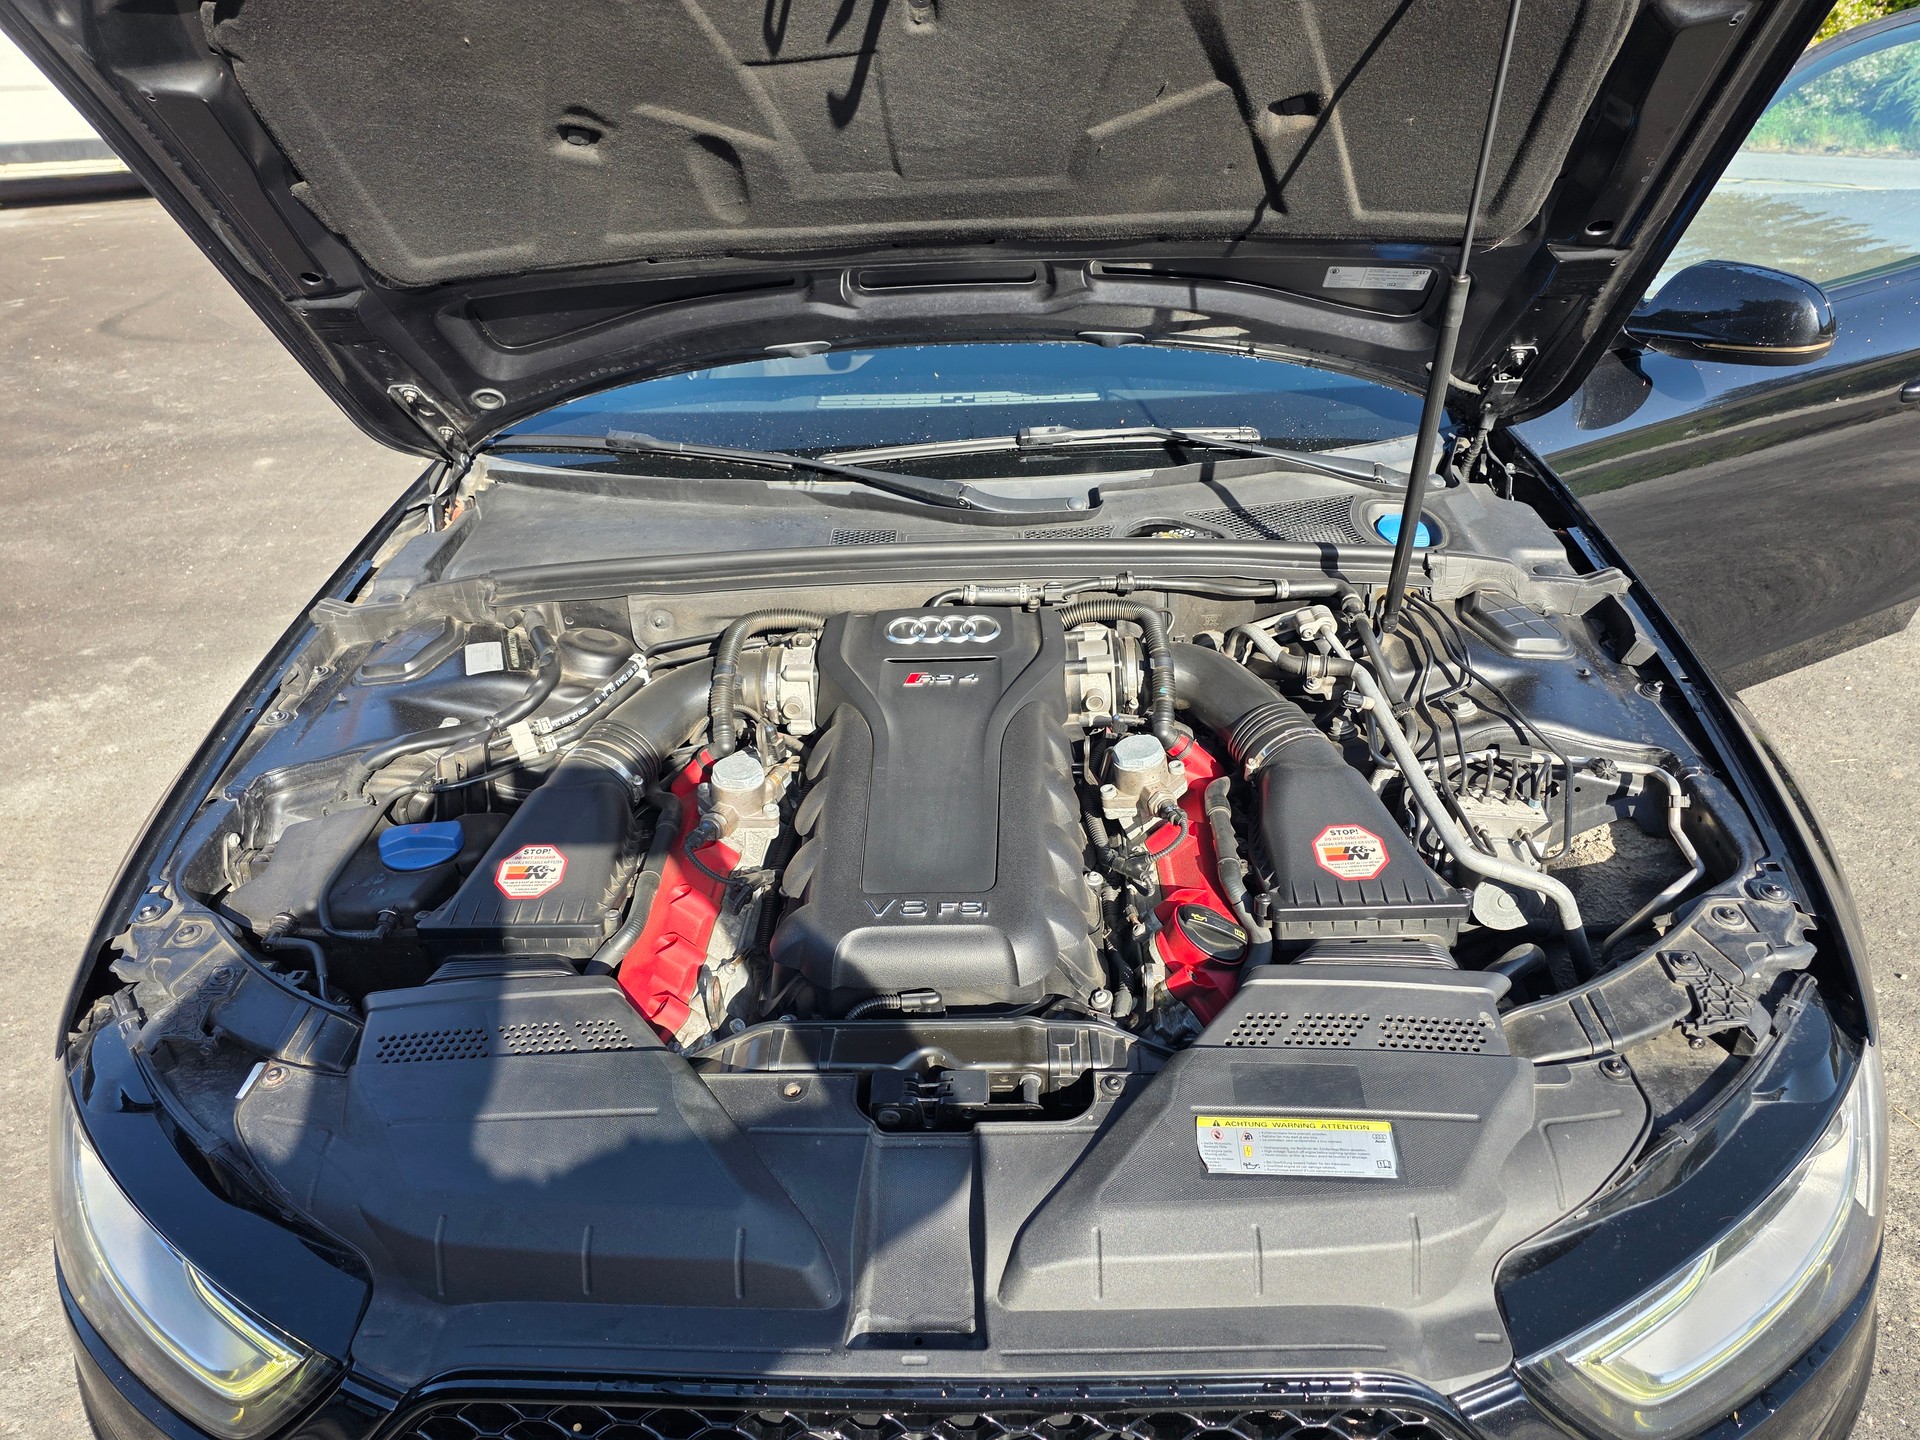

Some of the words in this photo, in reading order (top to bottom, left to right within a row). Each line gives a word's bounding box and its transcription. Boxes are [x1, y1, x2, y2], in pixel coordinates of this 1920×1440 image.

[959, 673, 979, 685] 4
[1330, 828, 1359, 836] STOP!
[1343, 845, 1376, 860] K&N
[523, 864, 556, 880] K&N
[865, 899, 928, 917] V8
[936, 901, 989, 917] FSI
[1225, 1120, 1268, 1128] ACHTUNG
[1321, 1123, 1370, 1131] ATTENTION
